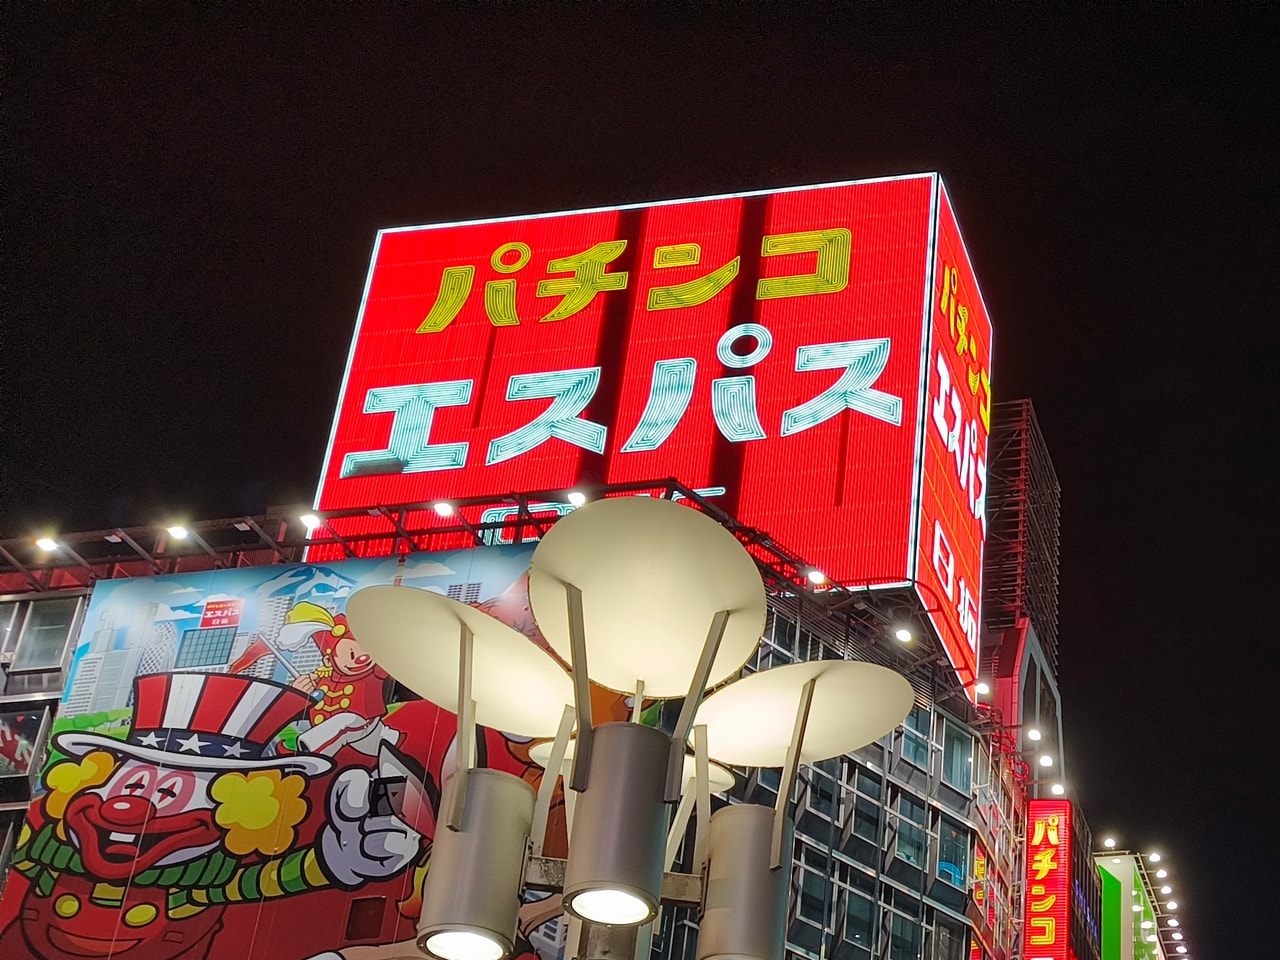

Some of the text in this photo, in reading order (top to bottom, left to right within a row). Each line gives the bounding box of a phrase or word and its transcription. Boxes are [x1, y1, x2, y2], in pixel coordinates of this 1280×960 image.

[416, 227, 852, 334] パチンコ
[340, 323, 902, 478] エスパス
[933, 350, 987, 521] エスパス
[1030, 815, 1059, 945] パチンコ
